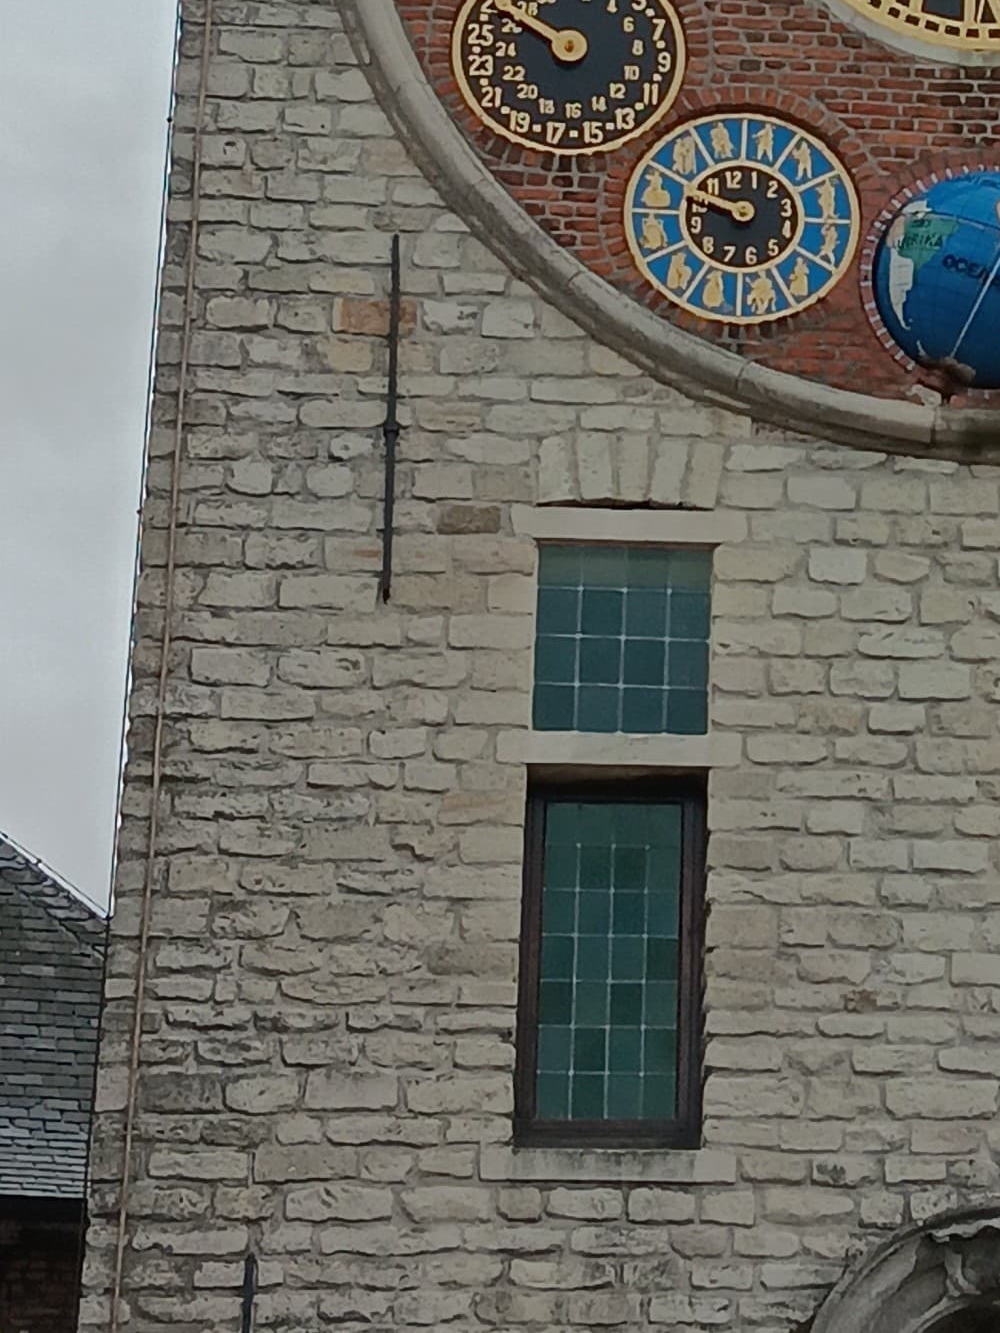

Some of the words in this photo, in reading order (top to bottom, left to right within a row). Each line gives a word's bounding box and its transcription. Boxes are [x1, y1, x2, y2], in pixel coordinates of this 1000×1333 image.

[607, 0, 617, 13] 4
[623, 18, 634, 32] 6
[653, 19, 666, 41] 7
[468, 24, 493, 45] 25
[496, 42, 516, 57] 24
[632, 40, 643, 55] 8
[468, 55, 493, 76] 23
[658, 52, 671, 72] 9
[503, 66, 525, 81] 22
[624, 65, 639, 80] 10
[481, 88, 502, 107] 21
[517, 85, 538, 99] 20
[610, 84, 625, 99] 12
[644, 84, 659, 105] 11
[565, 103, 581, 118] 16
[616, 108, 635, 129] 13
[510, 110, 530, 132] 19
[546, 122, 565, 144] 17
[583, 122, 603, 143] 15
[707, 178, 719, 195] 11
[725, 171, 741, 189] 12
[752, 171, 757, 189] 1
[767, 180, 778, 198] 2
[781, 200, 791, 217] 3
[691, 217, 701, 234] 9
[783, 220, 791, 238] 4
[703, 237, 714, 253] 8
[768, 239, 779, 256] 5
[724, 246, 736, 262] 7
[745, 247, 757, 264] 6
